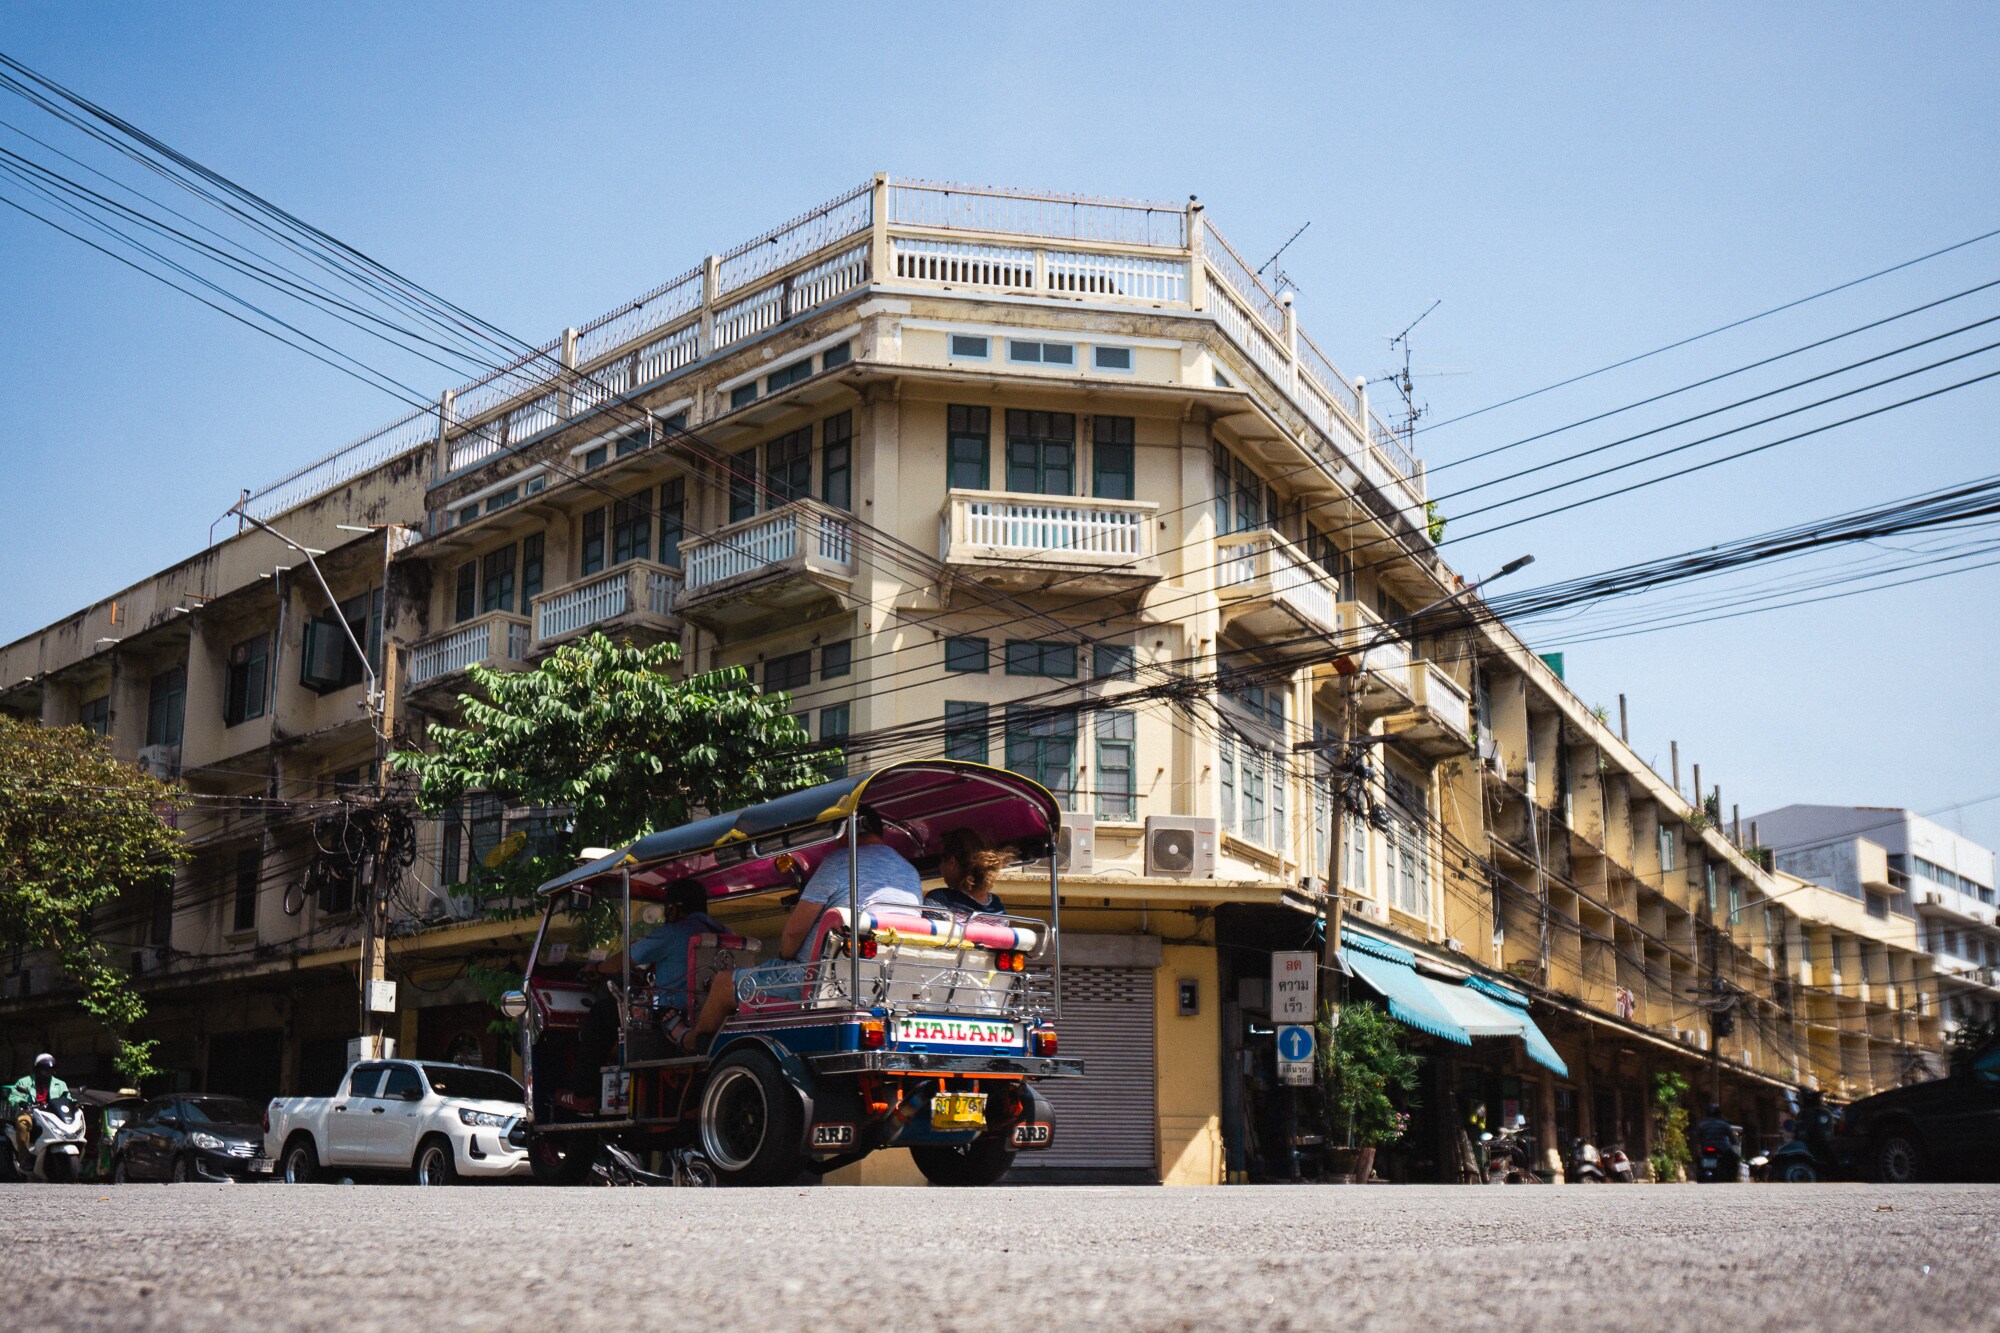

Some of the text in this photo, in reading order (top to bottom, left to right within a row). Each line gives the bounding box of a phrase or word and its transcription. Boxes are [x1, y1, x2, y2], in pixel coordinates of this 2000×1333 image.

[1286, 960, 1302, 971] ลด
[1278, 980, 1309, 992] ความ
[1284, 996, 1303, 1013] เร็ว
[900, 1019, 1015, 1043] THAILAND
[815, 1127, 852, 1143] ARB
[1015, 1126, 1048, 1142] ARB
